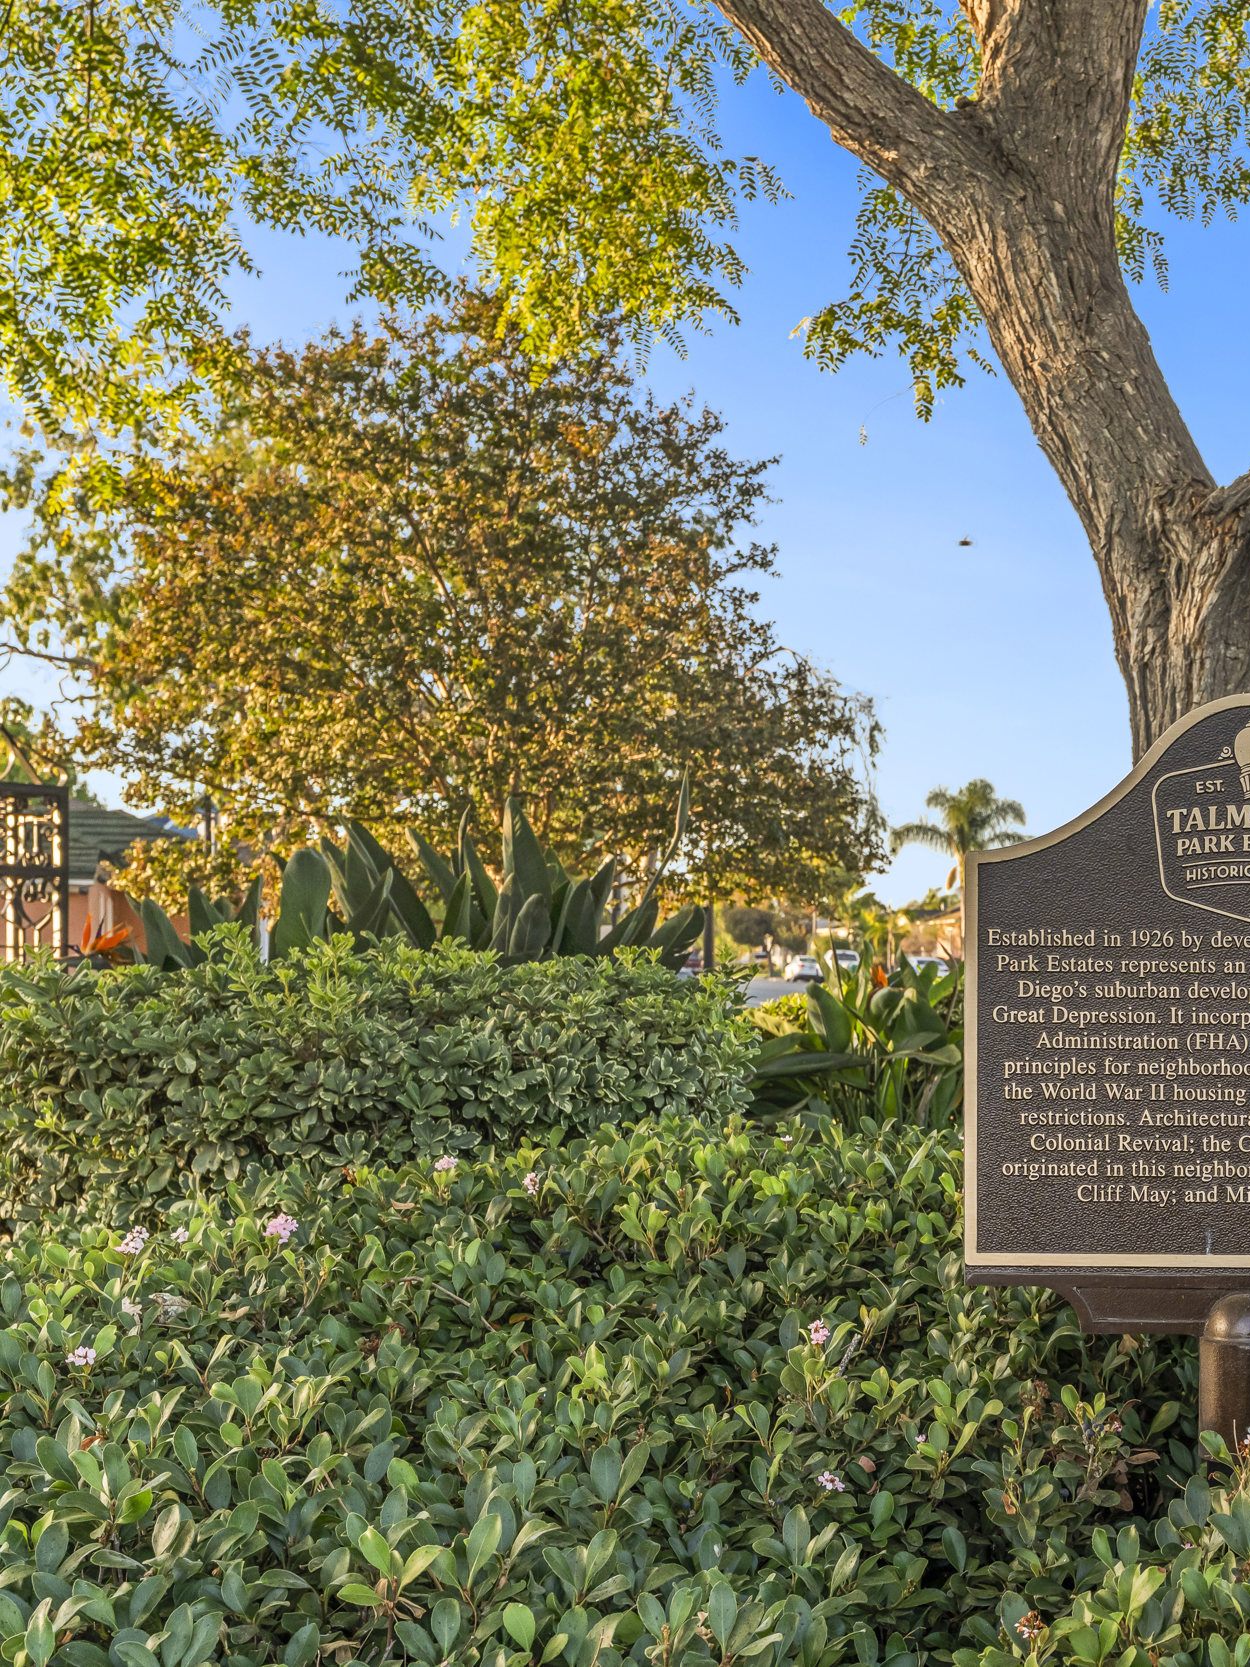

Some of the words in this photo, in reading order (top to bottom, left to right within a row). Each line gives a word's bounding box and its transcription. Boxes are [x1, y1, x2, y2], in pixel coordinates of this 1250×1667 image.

[1196, 780, 1225, 795] EST.
[1176, 835, 1235, 857] PARK
[988, 929, 1095, 947] Established
[1103, 931, 1122, 947] in
[1131, 930, 1174, 947] 1926
[1181, 931, 1203, 953] by
[997, 955, 1039, 972] Park
[1047, 955, 1113, 973] Estates
[1121, 958, 1216, 977] represents
[1224, 961, 1246, 974] an
[1095, 982, 1180, 999] suburban
[992, 1006, 1045, 1023] Great
[1052, 1006, 1162, 1028] Depression.
[1170, 1007, 1183, 1024] It
[1036, 1032, 1179, 1050] Administration
[1186, 1033, 1248, 1053] (FHA)
[1004, 1057, 1096, 1078] principles
[1103, 1058, 1131, 1075] for
[1004, 1083, 1033, 1100] the
[1041, 1083, 1096, 1100] World
[1104, 1084, 1143, 1100] War
[1150, 1085, 1165, 1100] II
[1173, 1084, 1246, 1105] housing
[1020, 1108, 1130, 1126] restrictions.
[1030, 1133, 1110, 1151] Colonial
[1117, 1134, 1195, 1154] Revival;
[1202, 1136, 1231, 1152] the
[1002, 1159, 1098, 1180] originated
[1106, 1160, 1124, 1177] in
[1132, 1160, 1166, 1177] this
[1077, 1185, 1123, 1202] Cliff
[1130, 1185, 1177, 1207] May;
[1185, 1186, 1218, 1202] and
